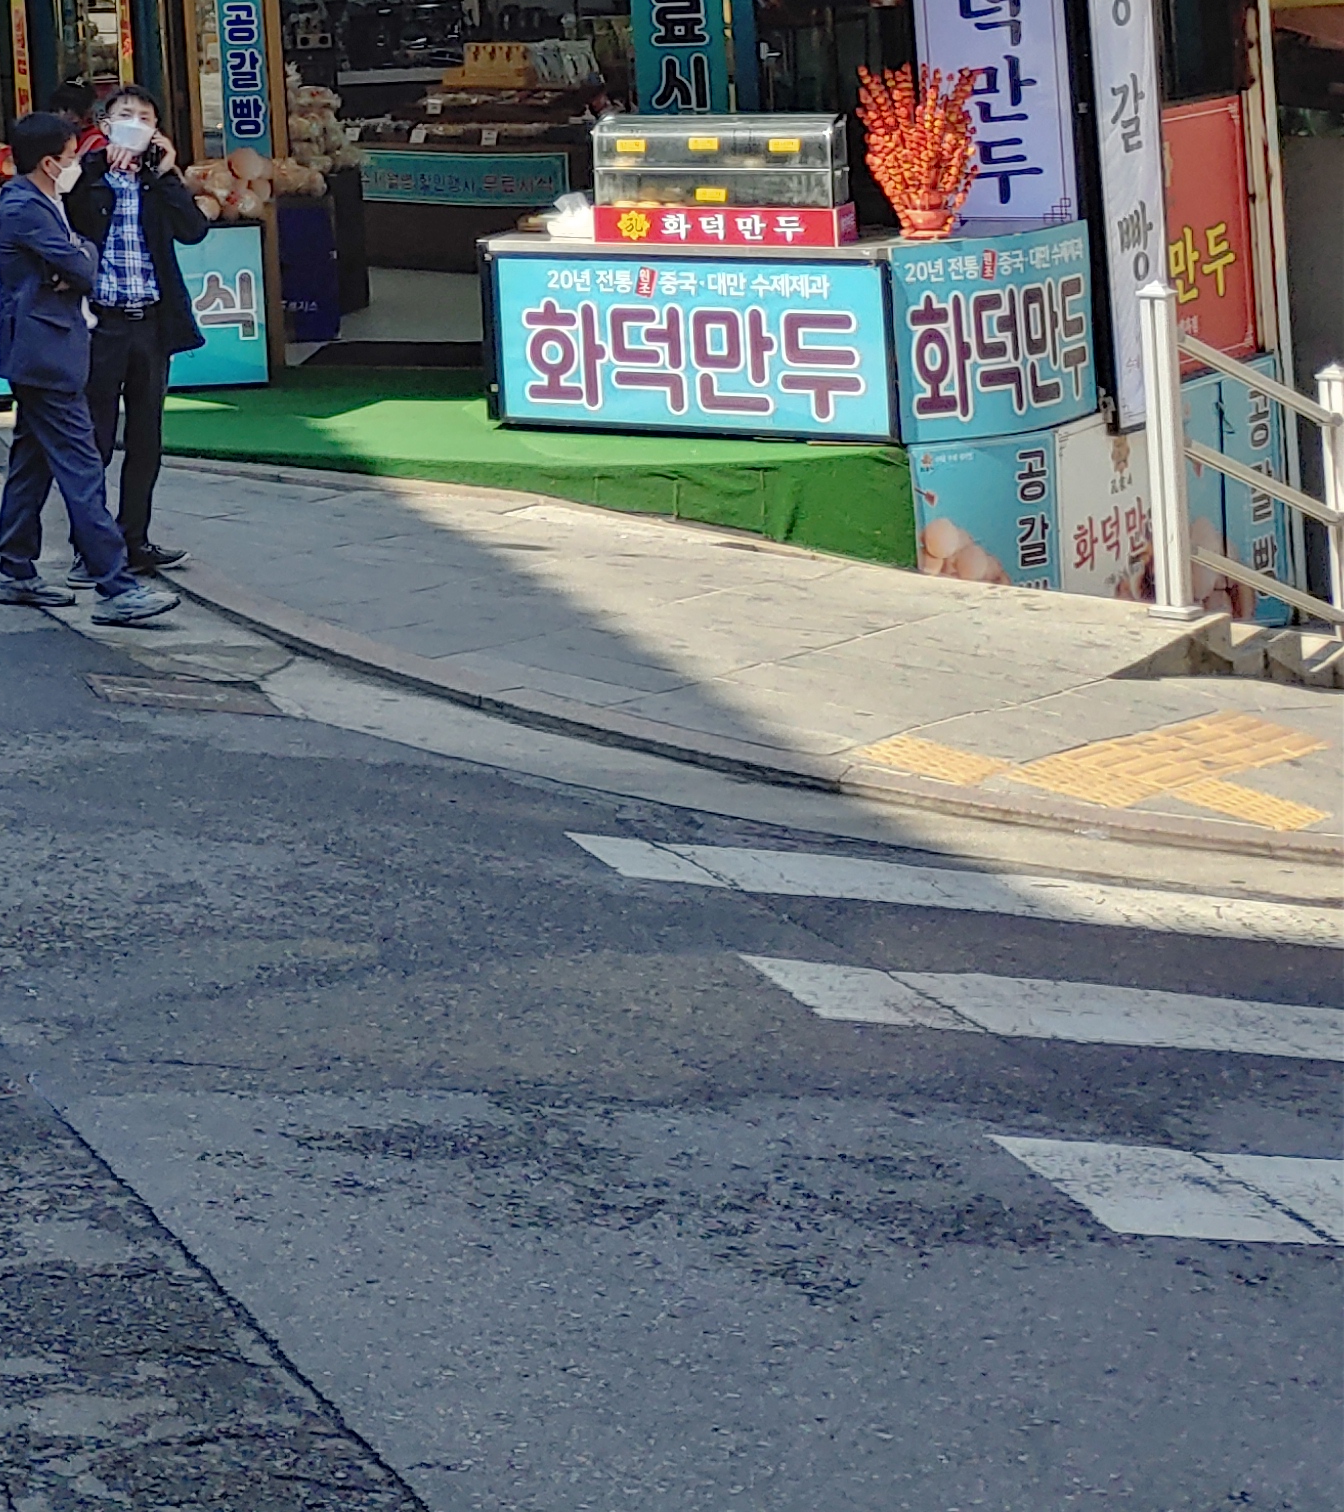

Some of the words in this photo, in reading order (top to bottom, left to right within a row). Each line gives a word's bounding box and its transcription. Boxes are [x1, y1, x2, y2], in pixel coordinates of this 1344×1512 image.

[224, 1, 265, 140] 공갈빵
[660, 212, 805, 242] 화덕만두
[1169, 221, 1236, 304] 만두
[547, 269, 591, 293] 20년
[595, 268, 633, 295] 전통
[749, 271, 830, 301] 수제제과
[903, 258, 945, 283] 20년
[947, 255, 980, 281] 전통
[523, 297, 862, 423] 화덕만두
[907, 273, 1089, 422] 화덕만두
